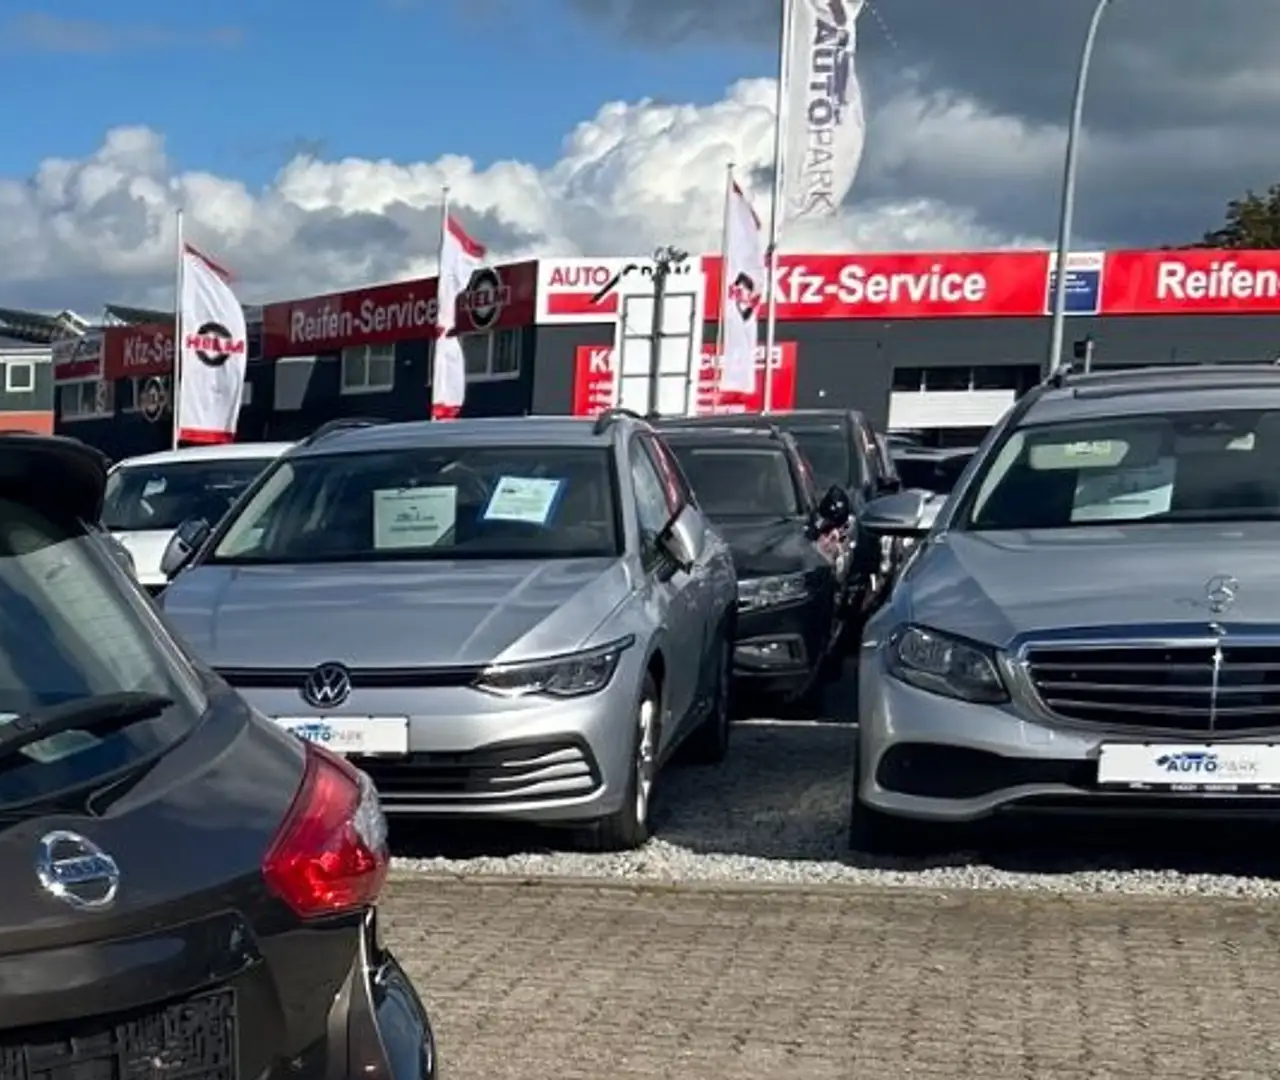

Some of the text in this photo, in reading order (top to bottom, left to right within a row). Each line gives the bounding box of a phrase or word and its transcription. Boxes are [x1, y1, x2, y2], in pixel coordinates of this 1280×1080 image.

[806, 19, 838, 217] AUTOPARK
[548, 265, 610, 286] AUTO
[762, 264, 986, 304] Kfz-Service
[1156, 260, 1279, 299] Reifen
[291, 292, 439, 343] Reifen-Service
[122, 332, 176, 367] Kfz-Se
